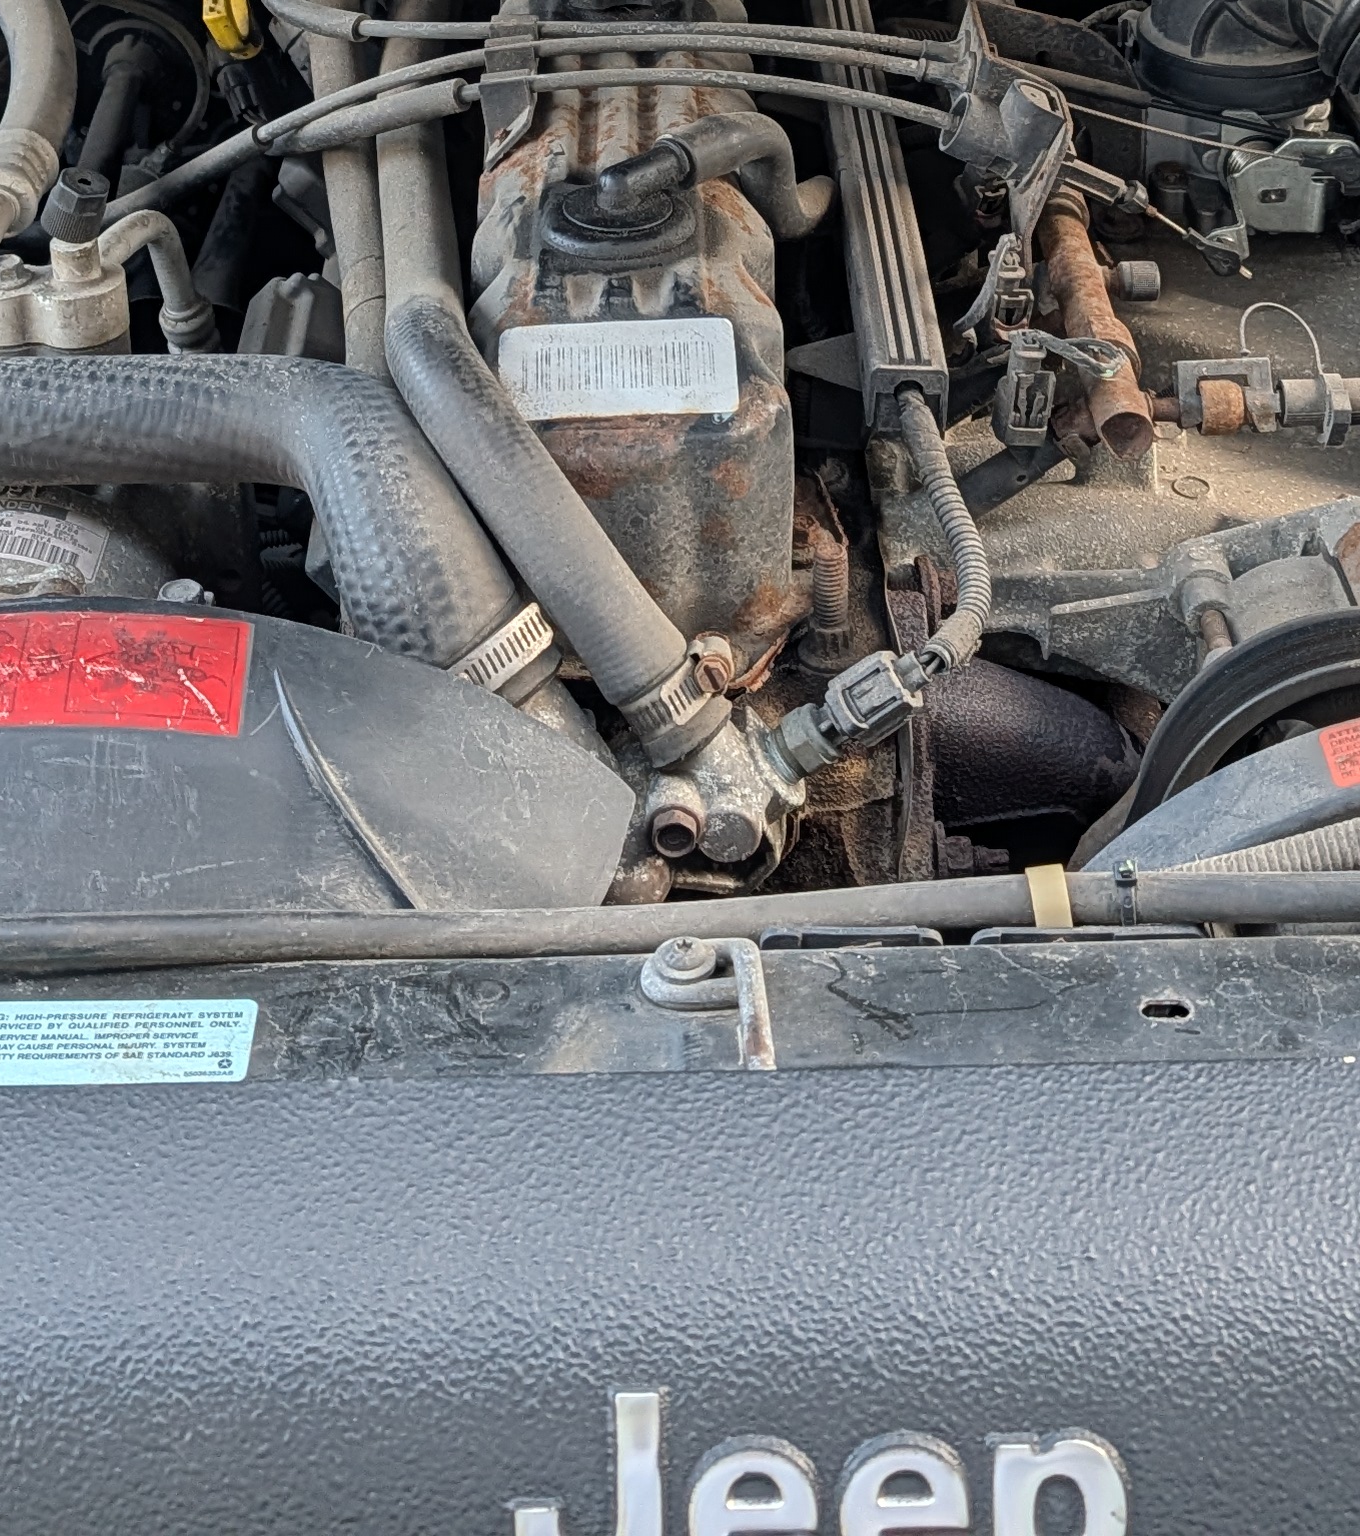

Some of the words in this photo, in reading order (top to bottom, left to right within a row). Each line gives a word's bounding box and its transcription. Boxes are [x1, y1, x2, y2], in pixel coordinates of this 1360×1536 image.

[15, 1013, 107, 1021] HIGH-PRESSURE
[112, 1012, 193, 1020] REFRIGERANT
[198, 1011, 243, 1019] SYSTEM
[47, 1022, 63, 1030] BY
[68, 1022, 129, 1030] QUALIFIED
[134, 1021, 204, 1029] PERSONNEL
[209, 1020, 241, 1028] ONLY.
[56, 1042, 114, 1050] PERSONAL
[163, 1041, 206, 1049] SYSTEM
[17, 1052, 102, 1060] REQUIREMENTS
[147, 1051, 205, 1059] STANDARD
